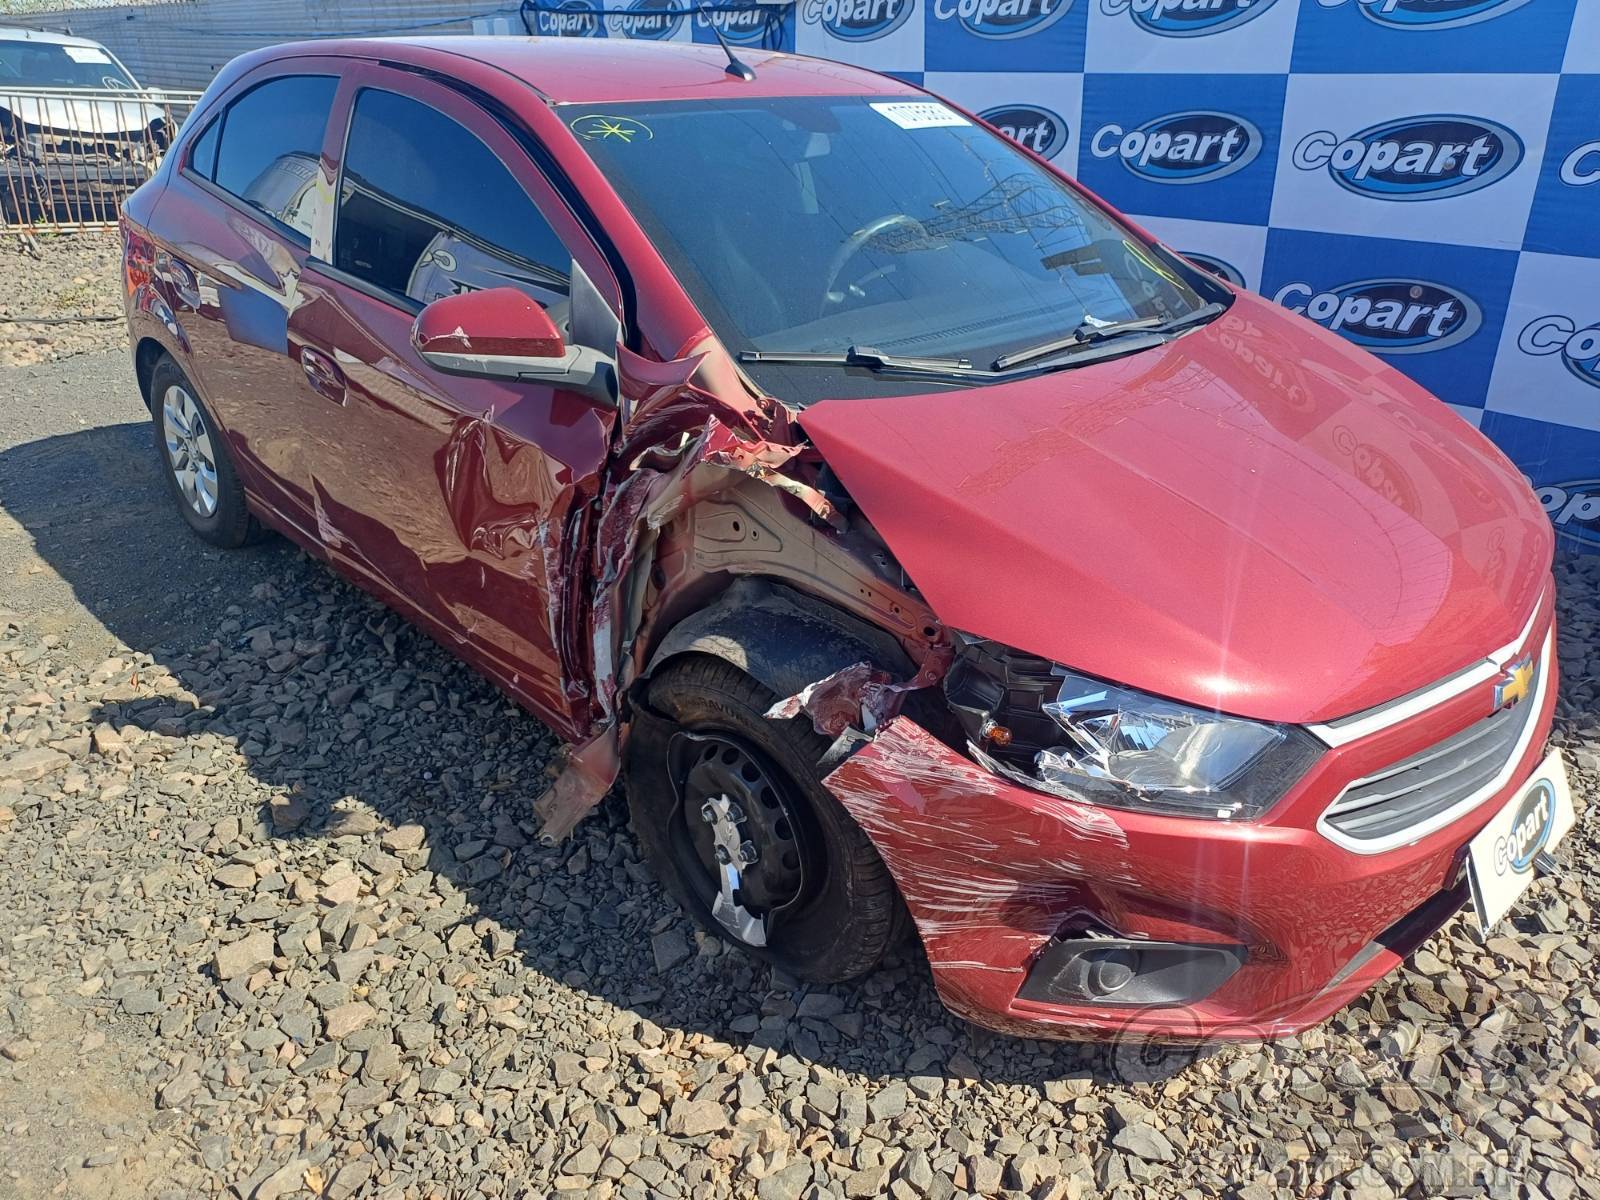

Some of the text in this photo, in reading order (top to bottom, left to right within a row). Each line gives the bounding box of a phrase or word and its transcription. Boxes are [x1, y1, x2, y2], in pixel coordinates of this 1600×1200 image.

[802, 0, 897, 27] Copart
[1090, 124, 1240, 167] Copart
[1292, 130, 1494, 181] Copart
[1272, 282, 1460, 338] Copart
[1494, 789, 1549, 877] Copart
